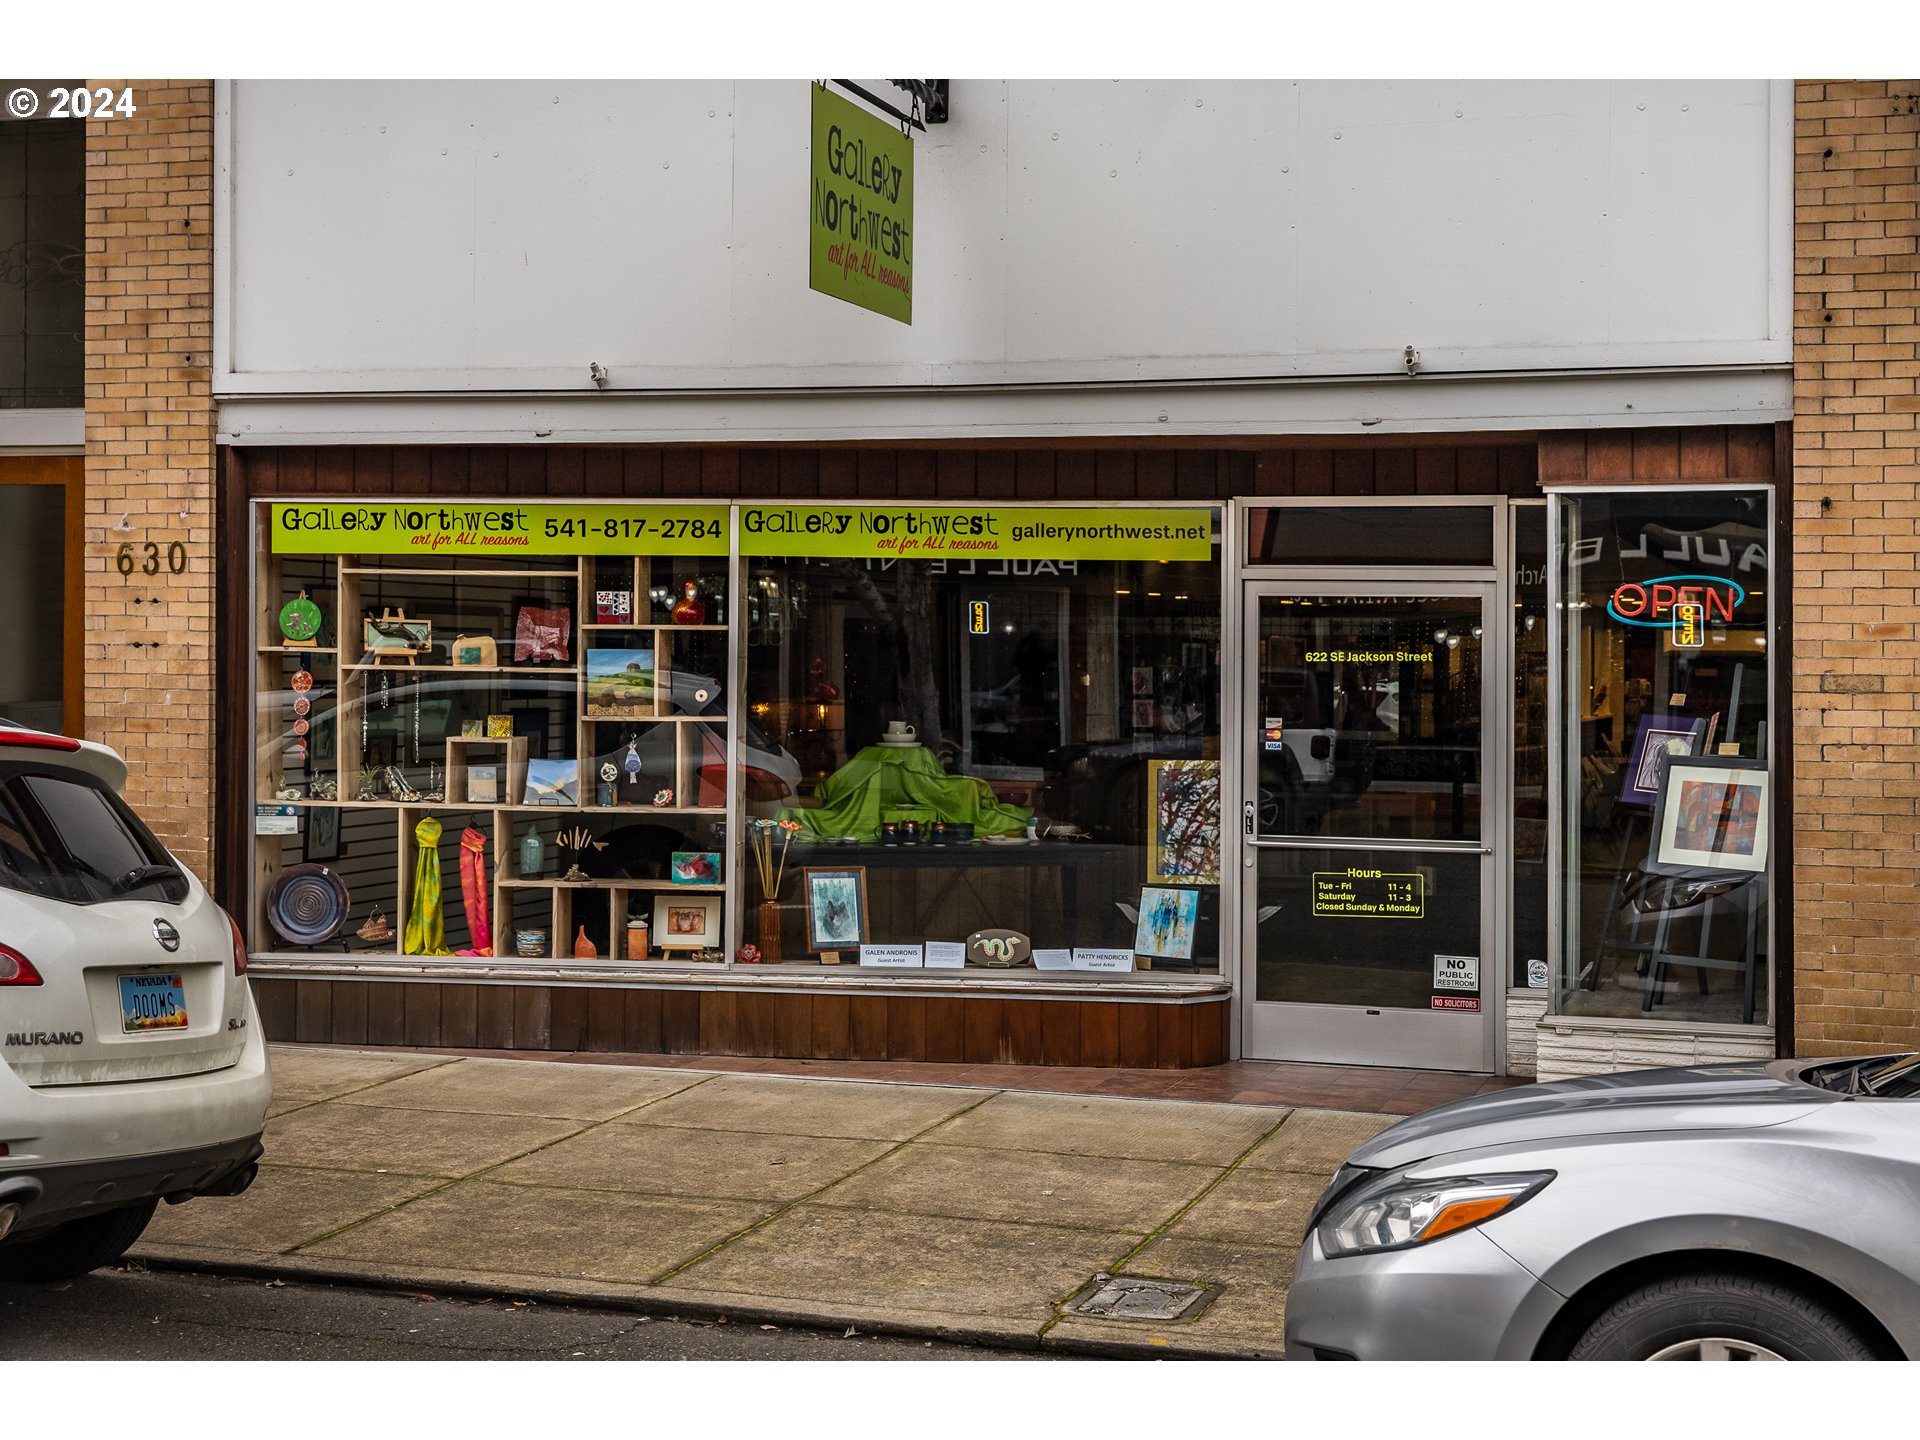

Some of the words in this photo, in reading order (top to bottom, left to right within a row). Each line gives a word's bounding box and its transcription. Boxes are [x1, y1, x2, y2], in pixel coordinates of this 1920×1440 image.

[816, 177, 910, 265] Northwest
[828, 242, 844, 266] art
[844, 243, 859, 280] for
[861, 251, 876, 279] ALL
[878, 264, 910, 294] reasons
[394, 508, 530, 531] Northwest
[860, 511, 999, 535] Northwest
[544, 518, 722, 539] 541-817-2784
[1012, 522, 1206, 542] gallerynorthwest.net
[411, 532, 431, 546] art
[431, 532, 453, 550] for
[455, 532, 477, 546] ALL
[480, 535, 530, 546] reasons
[876, 537, 898, 550] art
[898, 535, 919, 554] for
[922, 536, 945, 550] ALL
[948, 538, 1000, 551] reasons
[116, 540, 187, 575] 630
[1613, 583, 1736, 622] OPEN
[1305, 652, 1328, 662] 622
[1330, 652, 1345, 662] SE
[1346, 651, 1394, 662] Jackson
[1396, 651, 1433, 662] Street
[1347, 868, 1382, 878] Hours
[1318, 882, 1333, 890] Tue
[1341, 882, 1352, 890] Fri
[1388, 883, 1397, 891] 11
[1405, 883, 1412, 891] 4
[1318, 893, 1356, 902] Saturday
[1388, 894, 1397, 902] 11
[1405, 894, 1412, 902] 3
[1316, 902, 1344, 911] Closed
[1346, 903, 1377, 913] Sunday
[1386, 904, 1420, 914] Monday
[1446, 959, 1466, 970] NO
[1439, 970, 1473, 979] PUBLIC
[135, 976, 167, 987] NEVADA
[1437, 979, 1475, 987] RESTROOM
[1434, 998, 1443, 1007] NO
[1444, 999, 1477, 1009] SOLICITORS
[5, 1031, 84, 1046] MURANO
